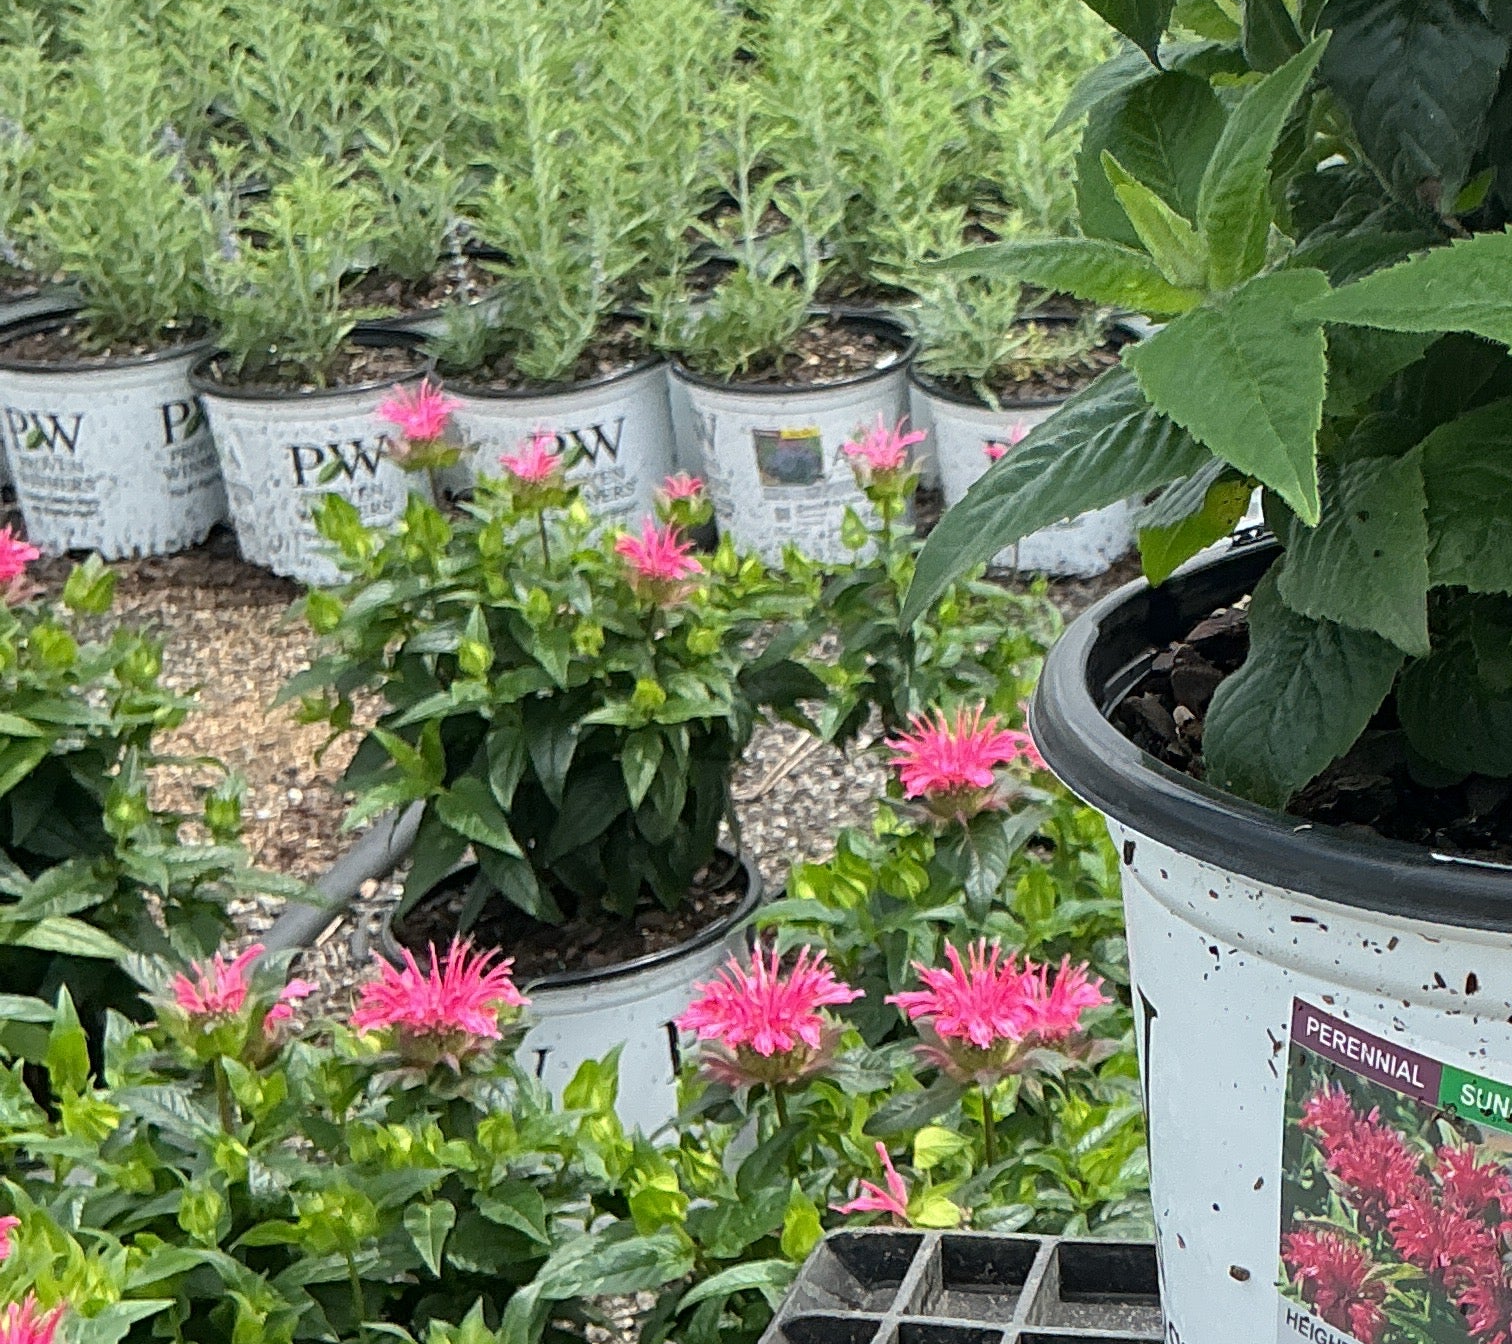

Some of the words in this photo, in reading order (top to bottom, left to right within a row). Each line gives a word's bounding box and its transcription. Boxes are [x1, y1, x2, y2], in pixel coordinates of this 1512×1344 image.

[5, 406, 84, 453] PW
[283, 434, 388, 488] PW
[1305, 1015, 1425, 1089] PERENNIAL
